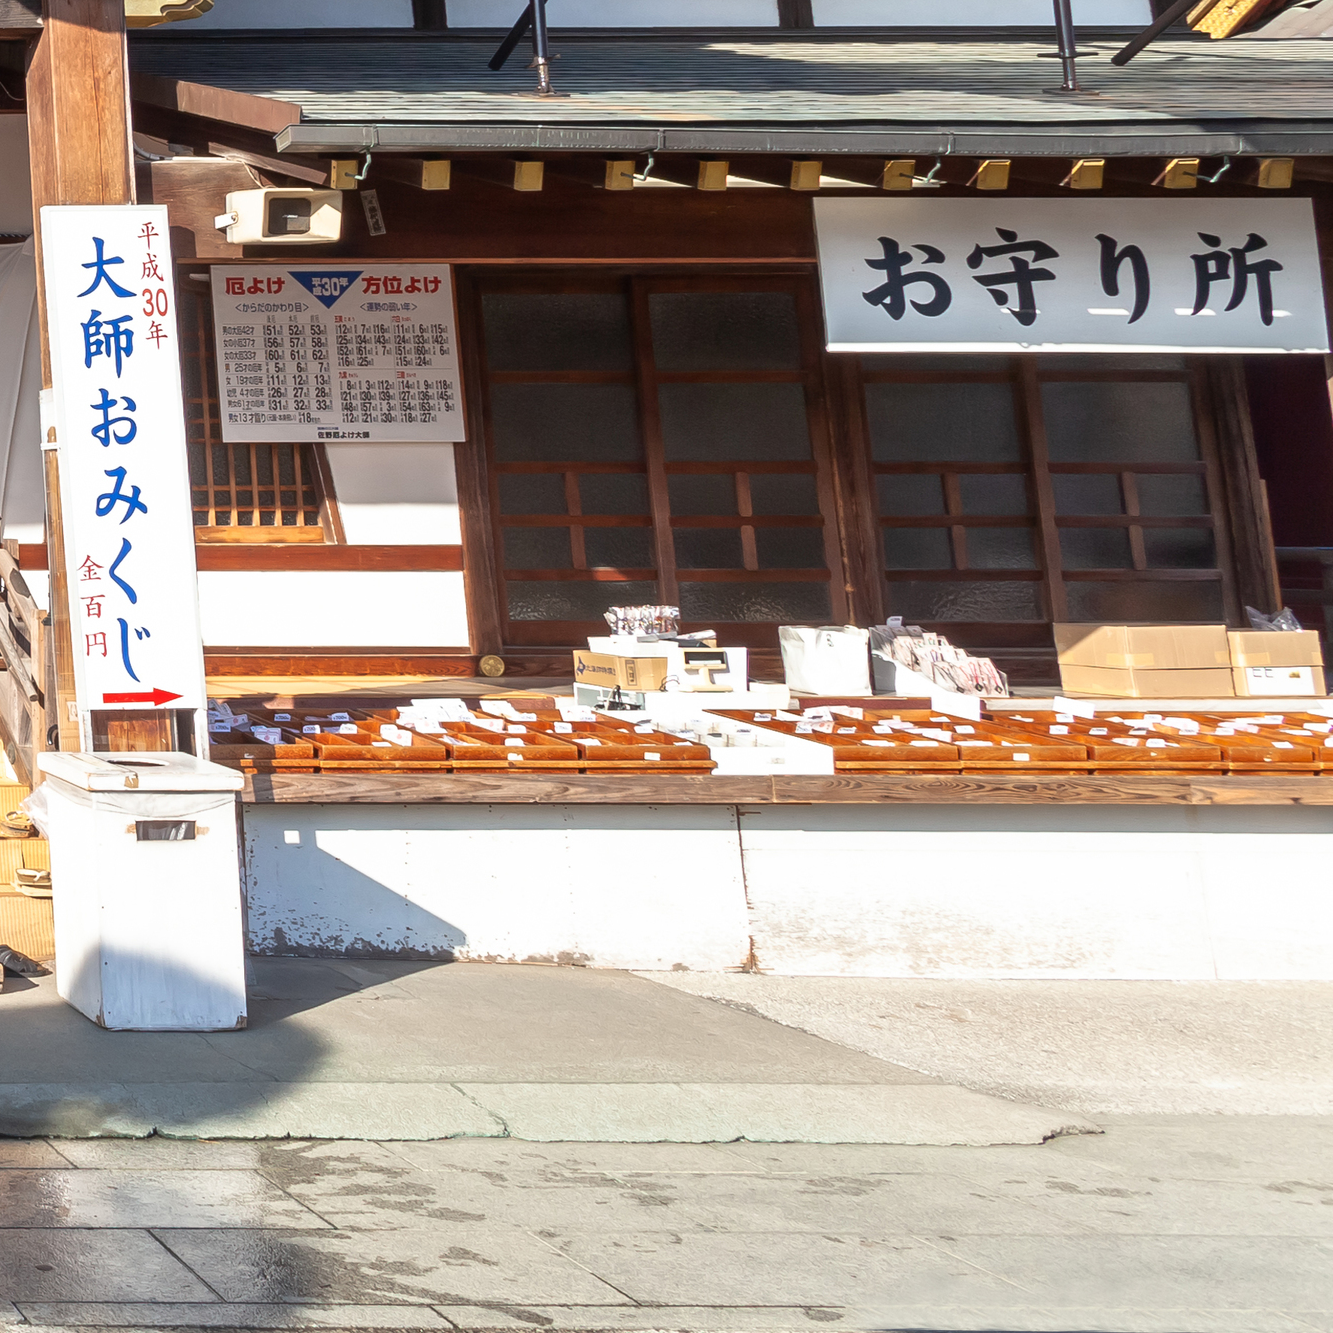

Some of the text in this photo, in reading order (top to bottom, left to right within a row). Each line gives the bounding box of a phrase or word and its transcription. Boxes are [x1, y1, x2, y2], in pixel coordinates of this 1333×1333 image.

[137, 222, 169, 350] 平成30年
[225, 277, 285, 295] 厄よけ
[362, 276, 442, 295] 方位よけ
[862, 227, 1283, 327] お守り所
[77, 236, 151, 683] 大師おみくじ
[77, 554, 108, 659] 金百円
